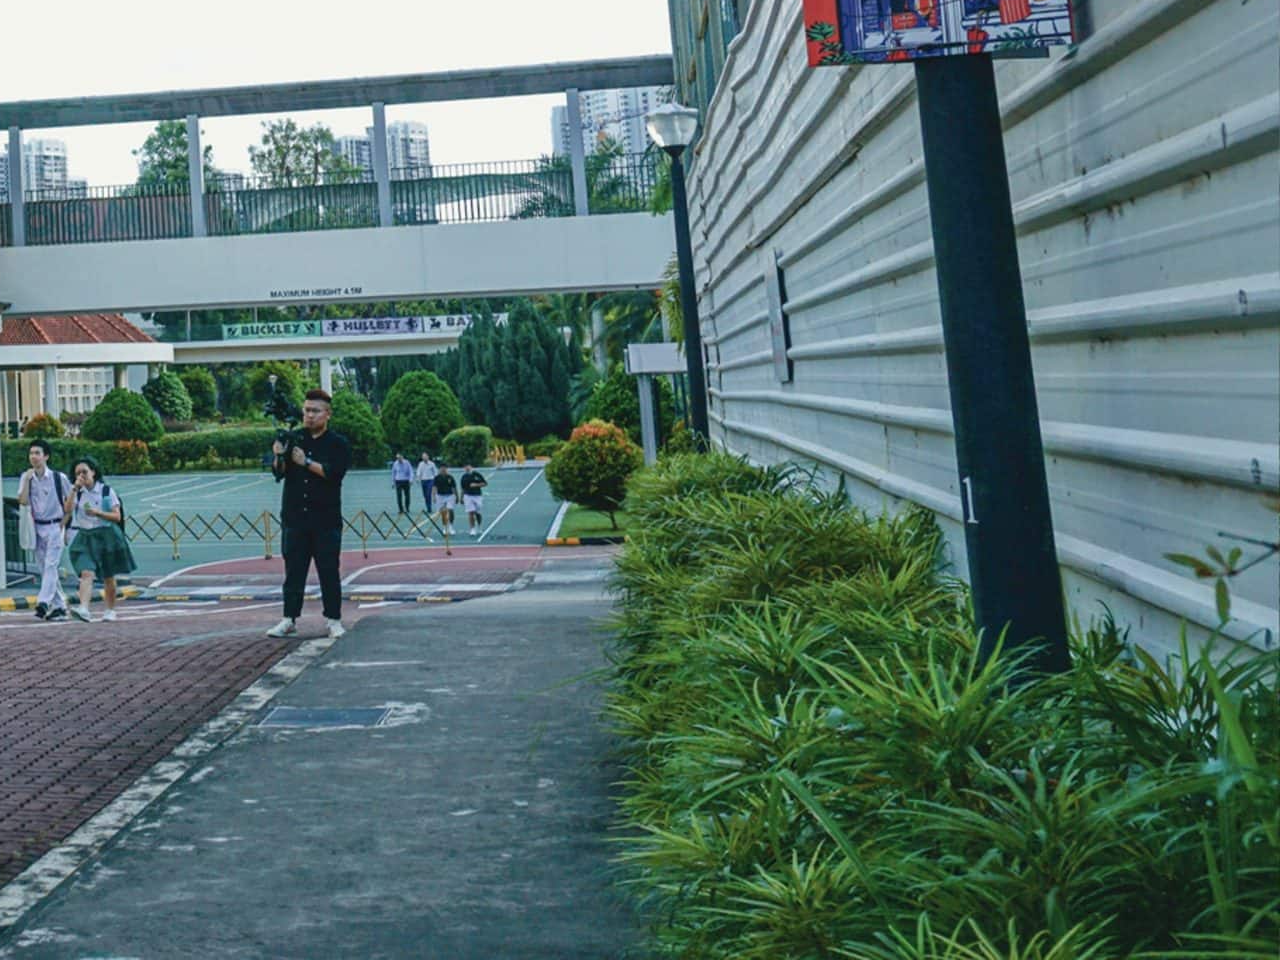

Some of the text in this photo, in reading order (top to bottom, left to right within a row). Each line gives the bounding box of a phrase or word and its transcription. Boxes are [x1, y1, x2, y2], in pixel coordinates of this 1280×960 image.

[270, 288, 309, 297] MAXIMUM
[311, 287, 341, 296] HEIGHT
[241, 323, 300, 336] BUCKLEY
